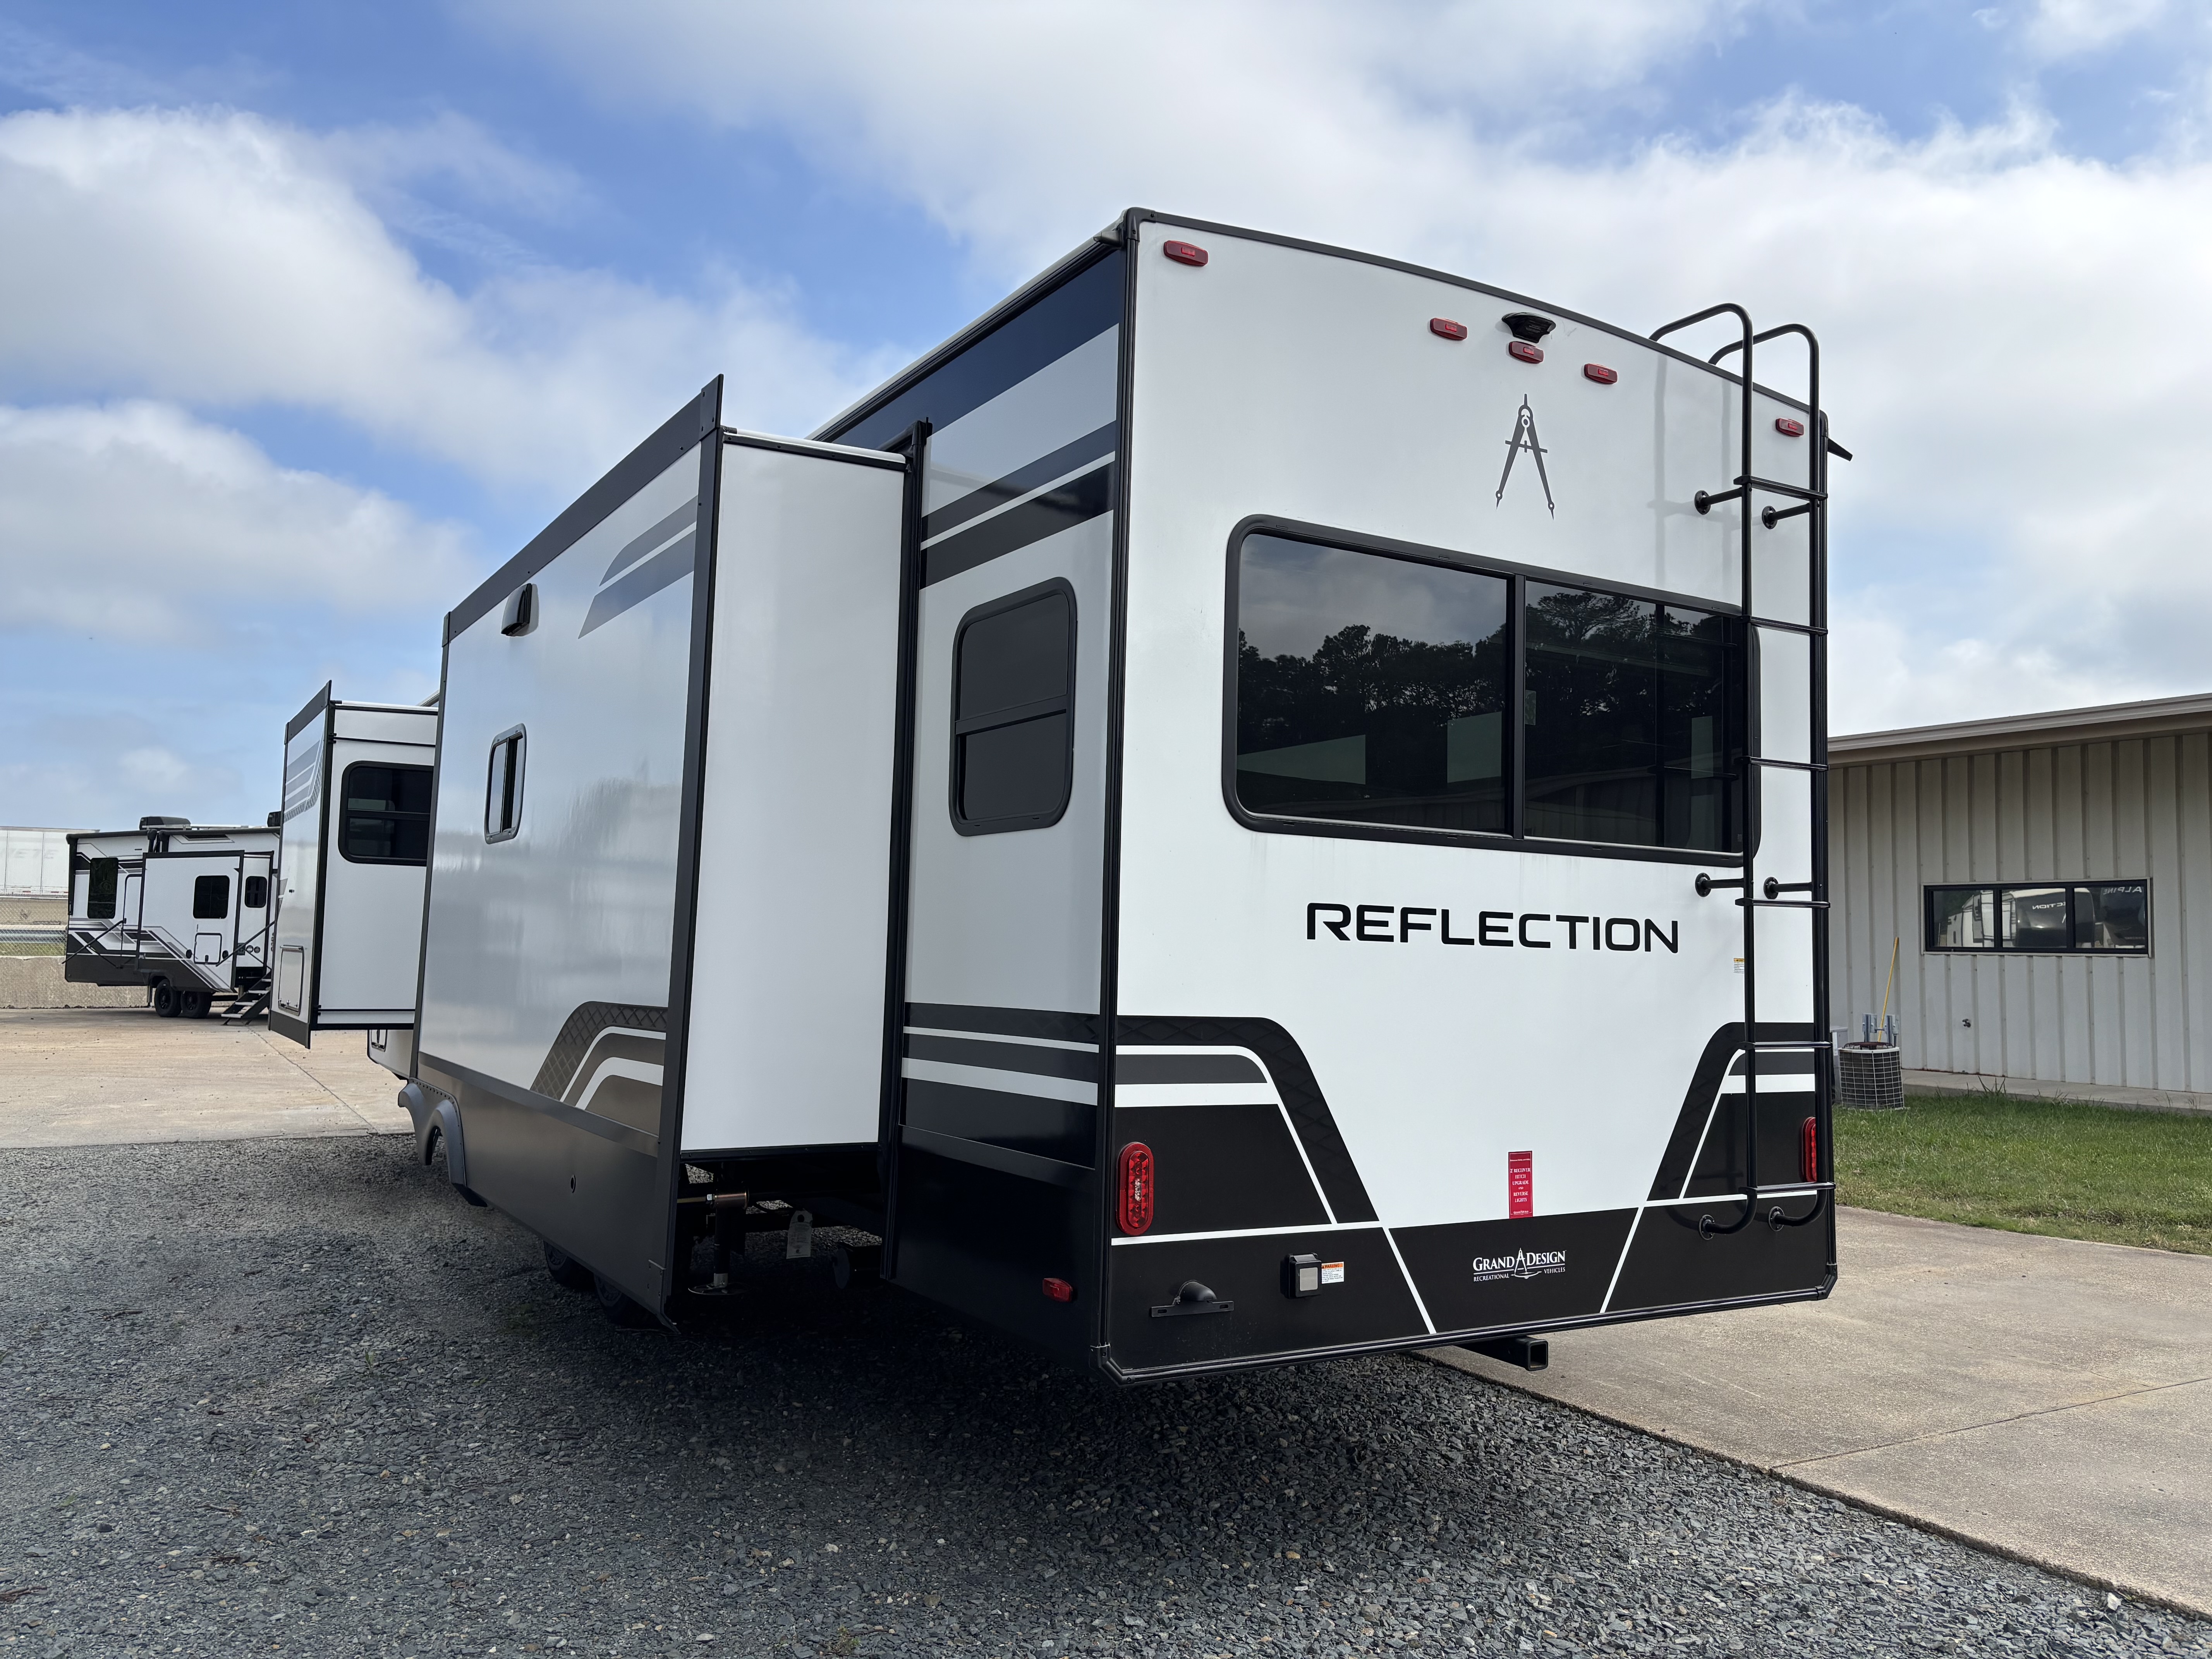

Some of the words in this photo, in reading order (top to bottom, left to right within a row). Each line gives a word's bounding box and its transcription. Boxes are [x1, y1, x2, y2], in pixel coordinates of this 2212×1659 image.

[1307, 903, 1678, 953] REFLECTION
[1473, 1256, 1515, 1271] GRAND
[1526, 1250, 1566, 1266] DESIGN
[1474, 1273, 1510, 1282] RECREATIONAL
